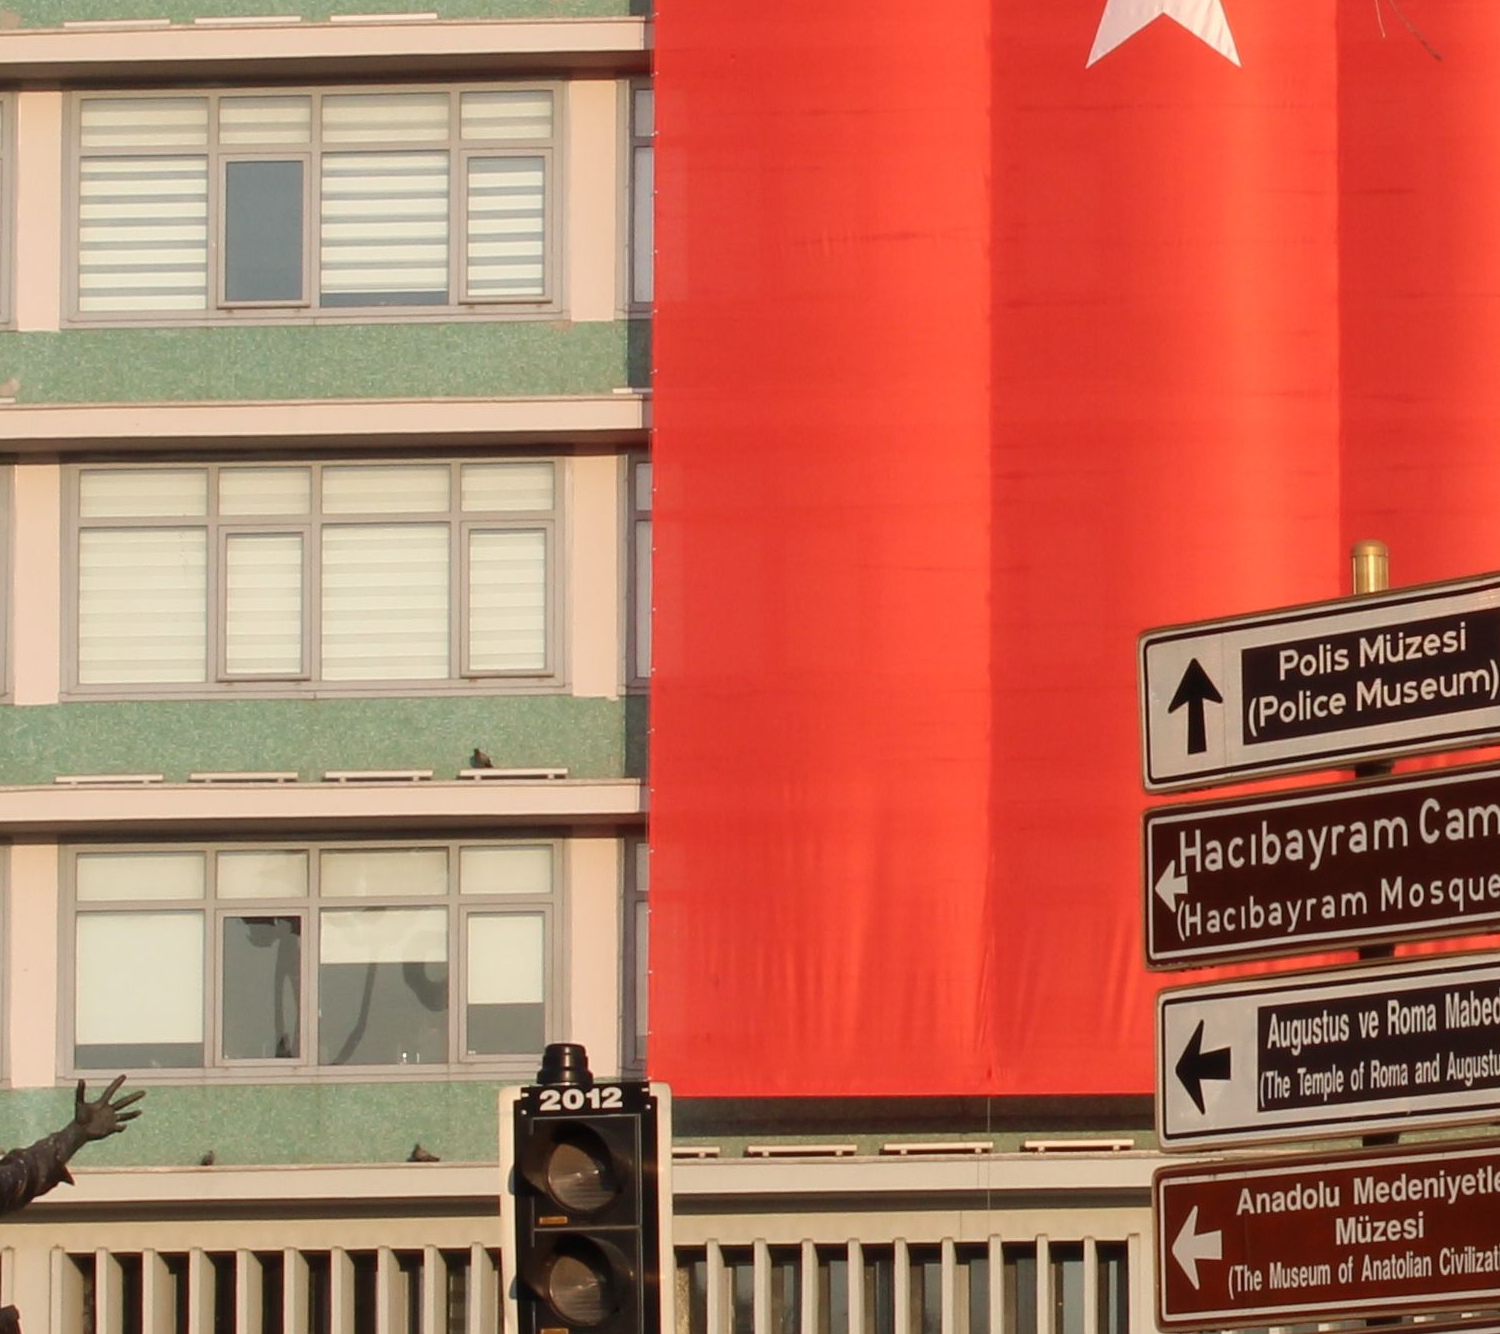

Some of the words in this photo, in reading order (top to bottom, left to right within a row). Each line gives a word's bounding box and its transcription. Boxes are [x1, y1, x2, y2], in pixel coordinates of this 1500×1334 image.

[1278, 644, 1349, 681] Polis
[1359, 621, 1467, 667] Müzesi
[1247, 691, 1346, 736] (Police
[1356, 660, 1500, 715] Museum)
[1179, 814, 1409, 875] Hacıbayram
[1176, 882, 1369, 942] (Hacıbayram
[1267, 1009, 1349, 1056] Augustus
[1359, 1015, 1379, 1039] ve
[1387, 1003, 1437, 1036] Roma
[539, 1087, 624, 1112] 2012
[1259, 1071, 1290, 1107] (The
[1297, 1063, 1344, 1101] Temple
[1350, 1060, 1365, 1091] of
[1370, 1058, 1409, 1087] Roma
[1415, 1054, 1440, 1085] and
[1236, 1179, 1340, 1216] Anadolu
[1335, 1211, 1425, 1245] Müzesi
[1228, 1260, 1263, 1299] (The
[1268, 1255, 1331, 1291] Museum
[1338, 1254, 1354, 1284] of
[1361, 1247, 1432, 1283] Anatolian
